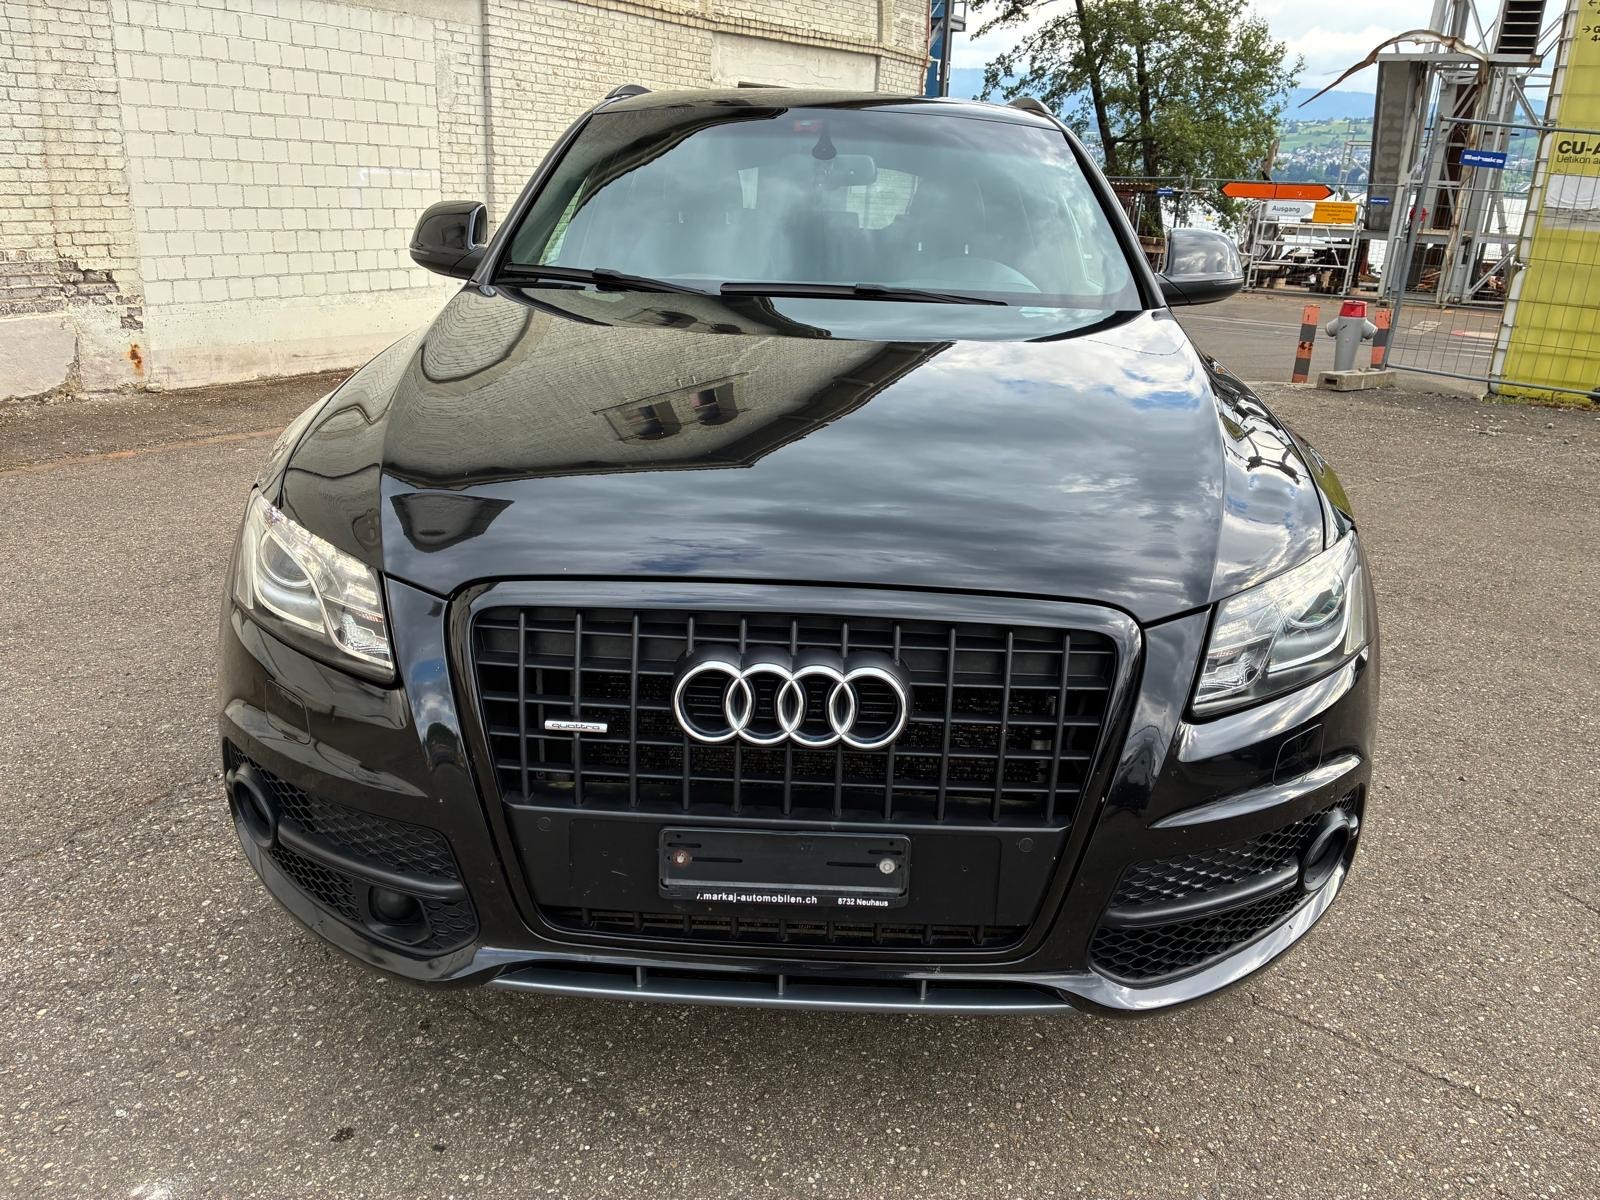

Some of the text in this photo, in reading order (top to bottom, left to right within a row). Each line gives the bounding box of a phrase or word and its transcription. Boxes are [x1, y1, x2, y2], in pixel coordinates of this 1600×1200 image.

[1556, 155, 1591, 164] Uetikon
[1272, 205, 1301, 213] Ausgang
[696, 892, 818, 904] .markaj-automobilen.ch
[838, 897, 889, 907] 8732 Neuhaus
